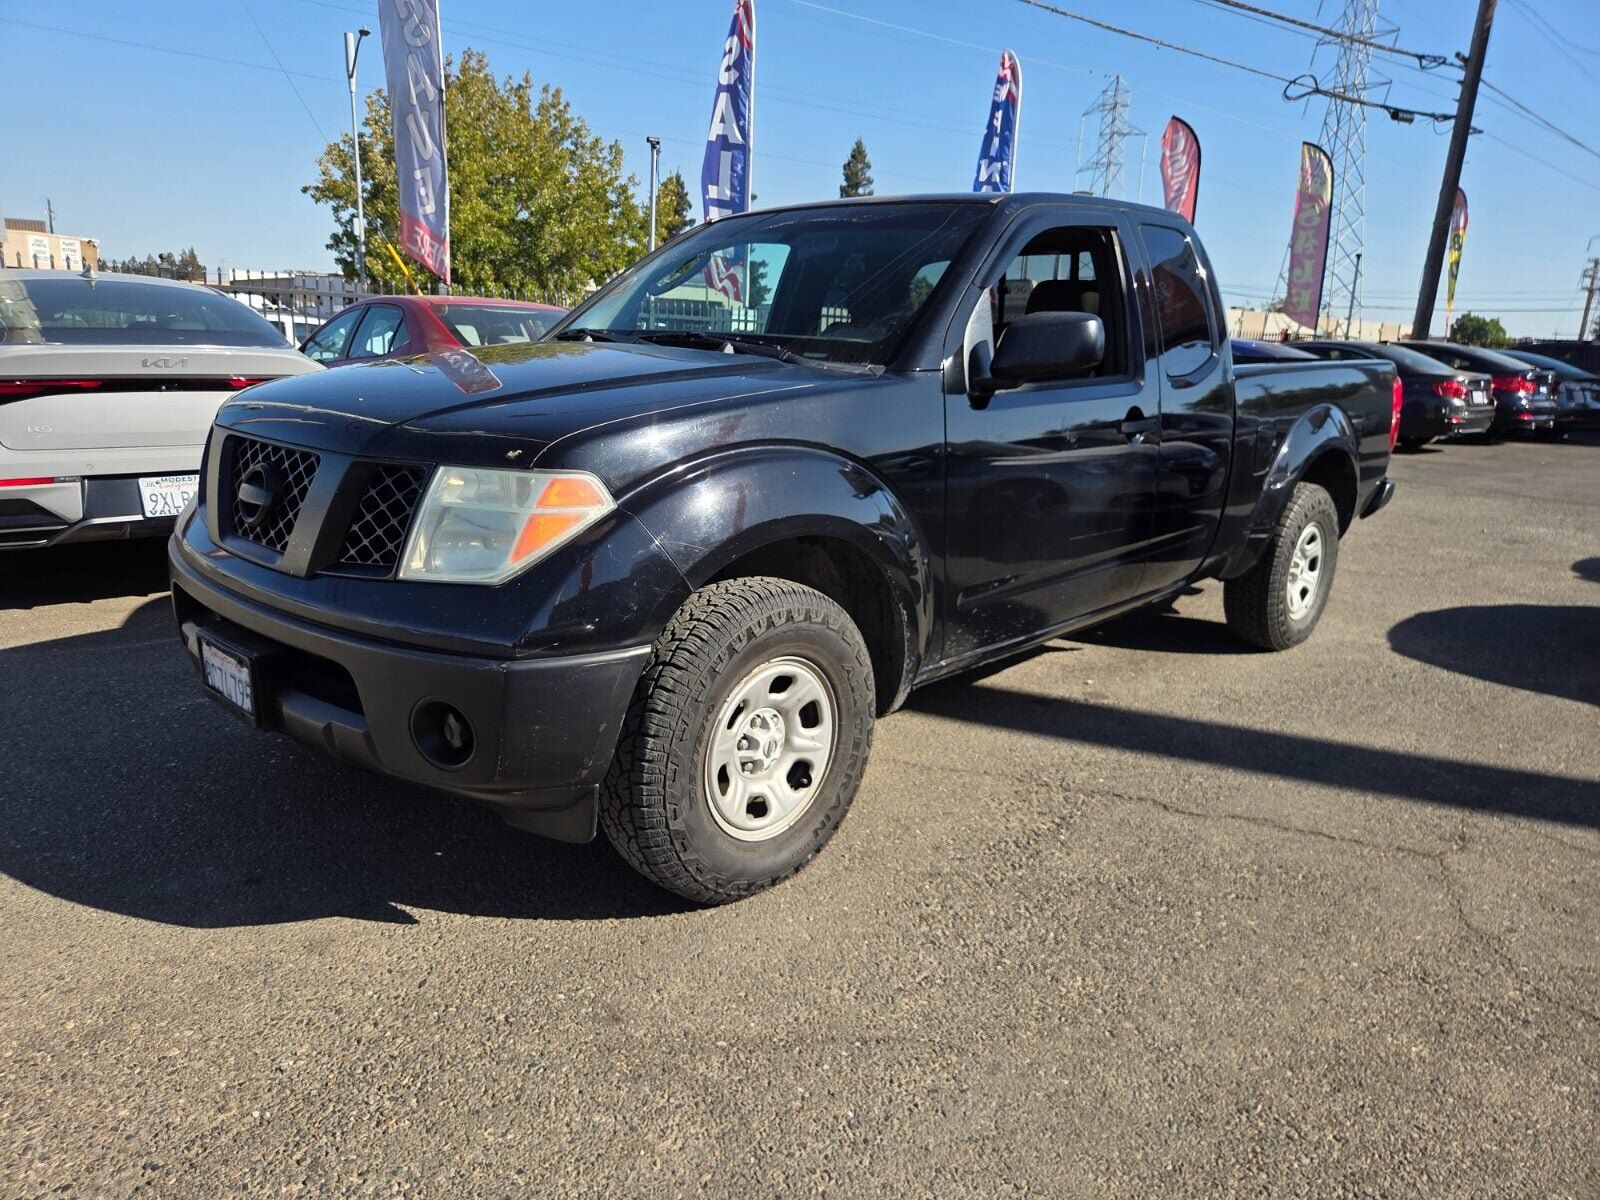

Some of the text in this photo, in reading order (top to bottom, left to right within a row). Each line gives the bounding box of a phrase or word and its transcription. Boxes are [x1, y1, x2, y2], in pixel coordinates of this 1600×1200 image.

[142, 358, 188, 369] KIA
[811, 664, 864, 839] ALL TERRAIN
